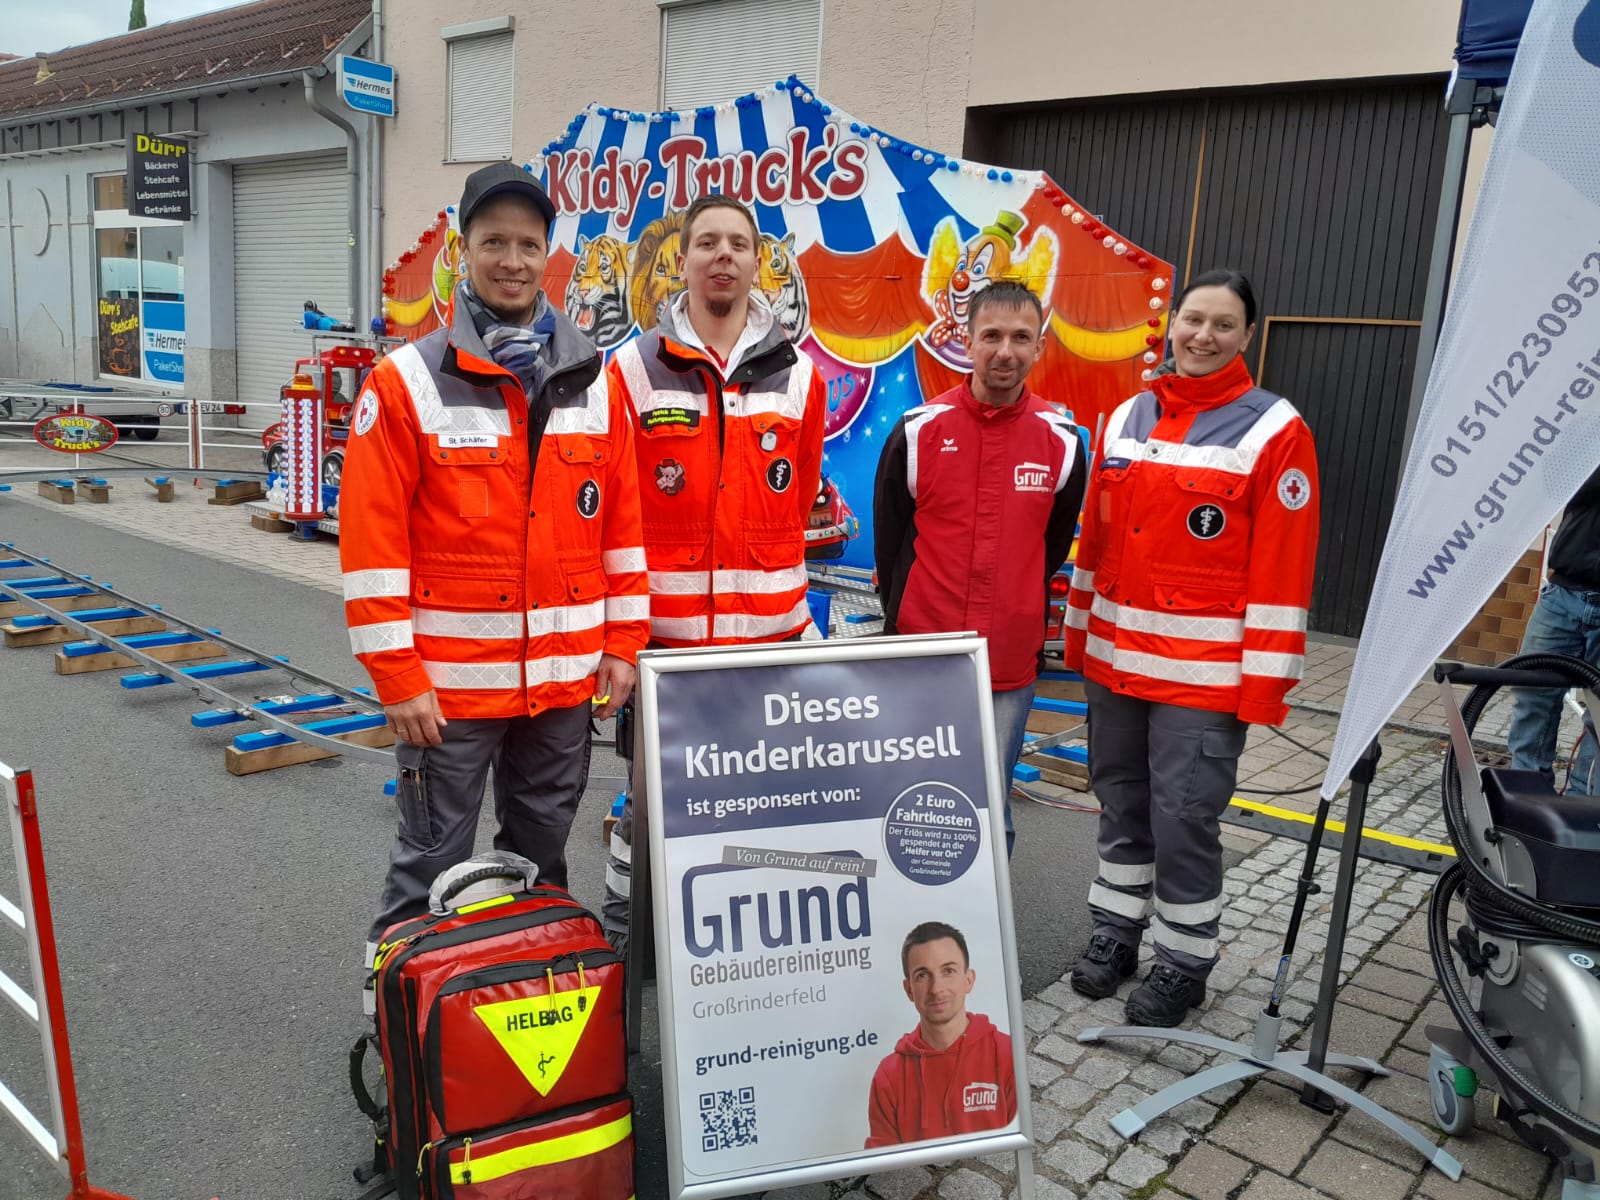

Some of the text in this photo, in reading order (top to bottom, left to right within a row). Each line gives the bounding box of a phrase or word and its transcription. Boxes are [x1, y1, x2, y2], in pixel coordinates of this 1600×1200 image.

[356, 80, 391, 95] Hermes
[136, 134, 187, 158] Dürr
[144, 161, 179, 170] Bäckerei
[547, 124, 868, 229] Kidy-Truck's
[136, 189, 189, 200] Lebensmittel
[144, 204, 182, 214] Getränke
[153, 358, 184, 373] PaketSho
[1430, 239, 1600, 478] 0151/2230952
[160, 406, 170, 414] 80
[60, 417, 93, 430] Kidy
[763, 691, 880, 726] Dieses
[685, 725, 961, 779] Kinderkarussell
[686, 787, 861, 818] ist gesponsert von:
[915, 794, 956, 809] 2 Euro
[896, 808, 972, 827] Fahrtkosten
[888, 826, 977, 842] Der Erlös wird zu 100%
[900, 838, 940, 848] gespendet
[952, 841, 965, 850] die
[735, 849, 866, 873] Von Grund auf rein!
[921, 858, 951, 867] Gemeinde
[682, 850, 872, 958] Grund
[690, 946, 872, 987] Gebäudereinigung
[692, 984, 827, 1019] Großrinderfeld
[695, 1029, 879, 1076] grund-reinigung.de
[963, 1082, 998, 1107] Grund
